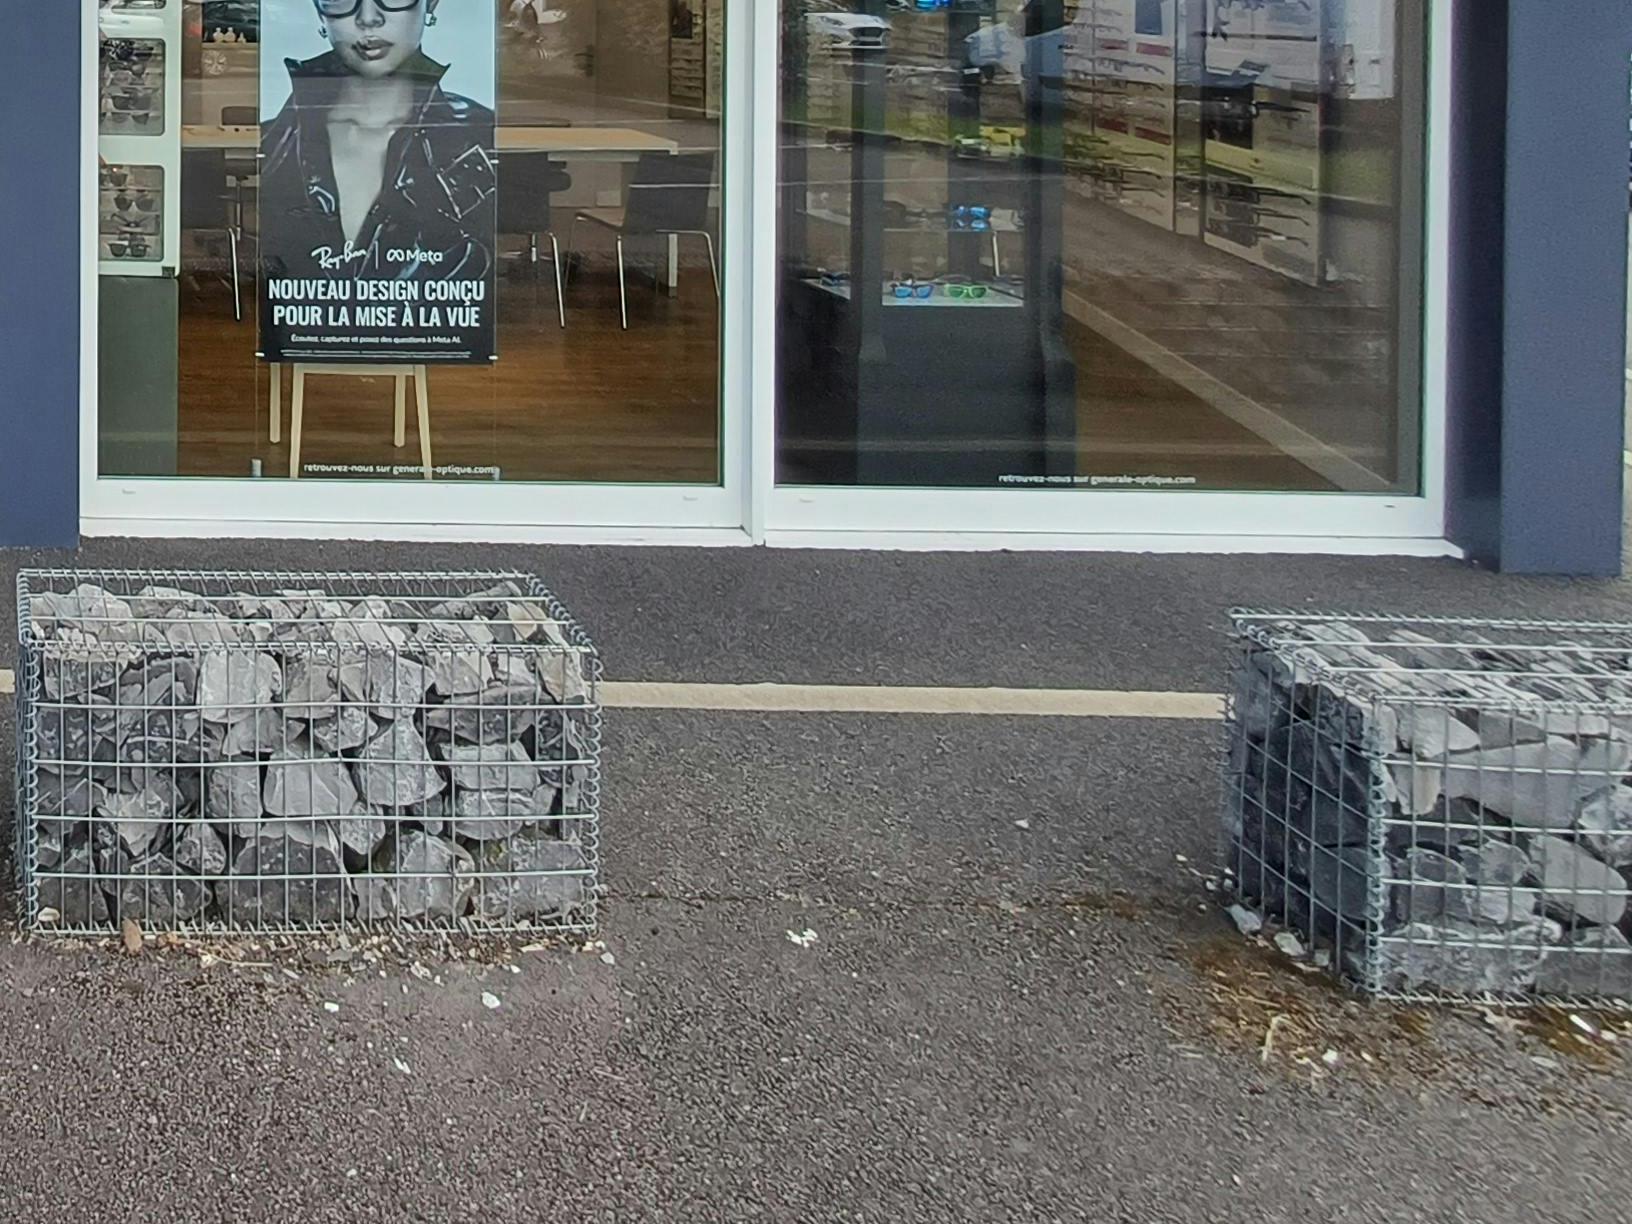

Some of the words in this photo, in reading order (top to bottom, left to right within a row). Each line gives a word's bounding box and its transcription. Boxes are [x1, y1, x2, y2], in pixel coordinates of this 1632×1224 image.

[268, 278, 351, 301] NOUVEAU
[356, 279, 419, 301] DESIGN
[424, 279, 486, 305] CONÇU
[273, 305, 323, 326] POUR
[328, 306, 350, 327] LA
[355, 306, 397, 327] MISE
[401, 301, 415, 327] À
[420, 306, 440, 327] LA
[446, 306, 481, 327] VUE
